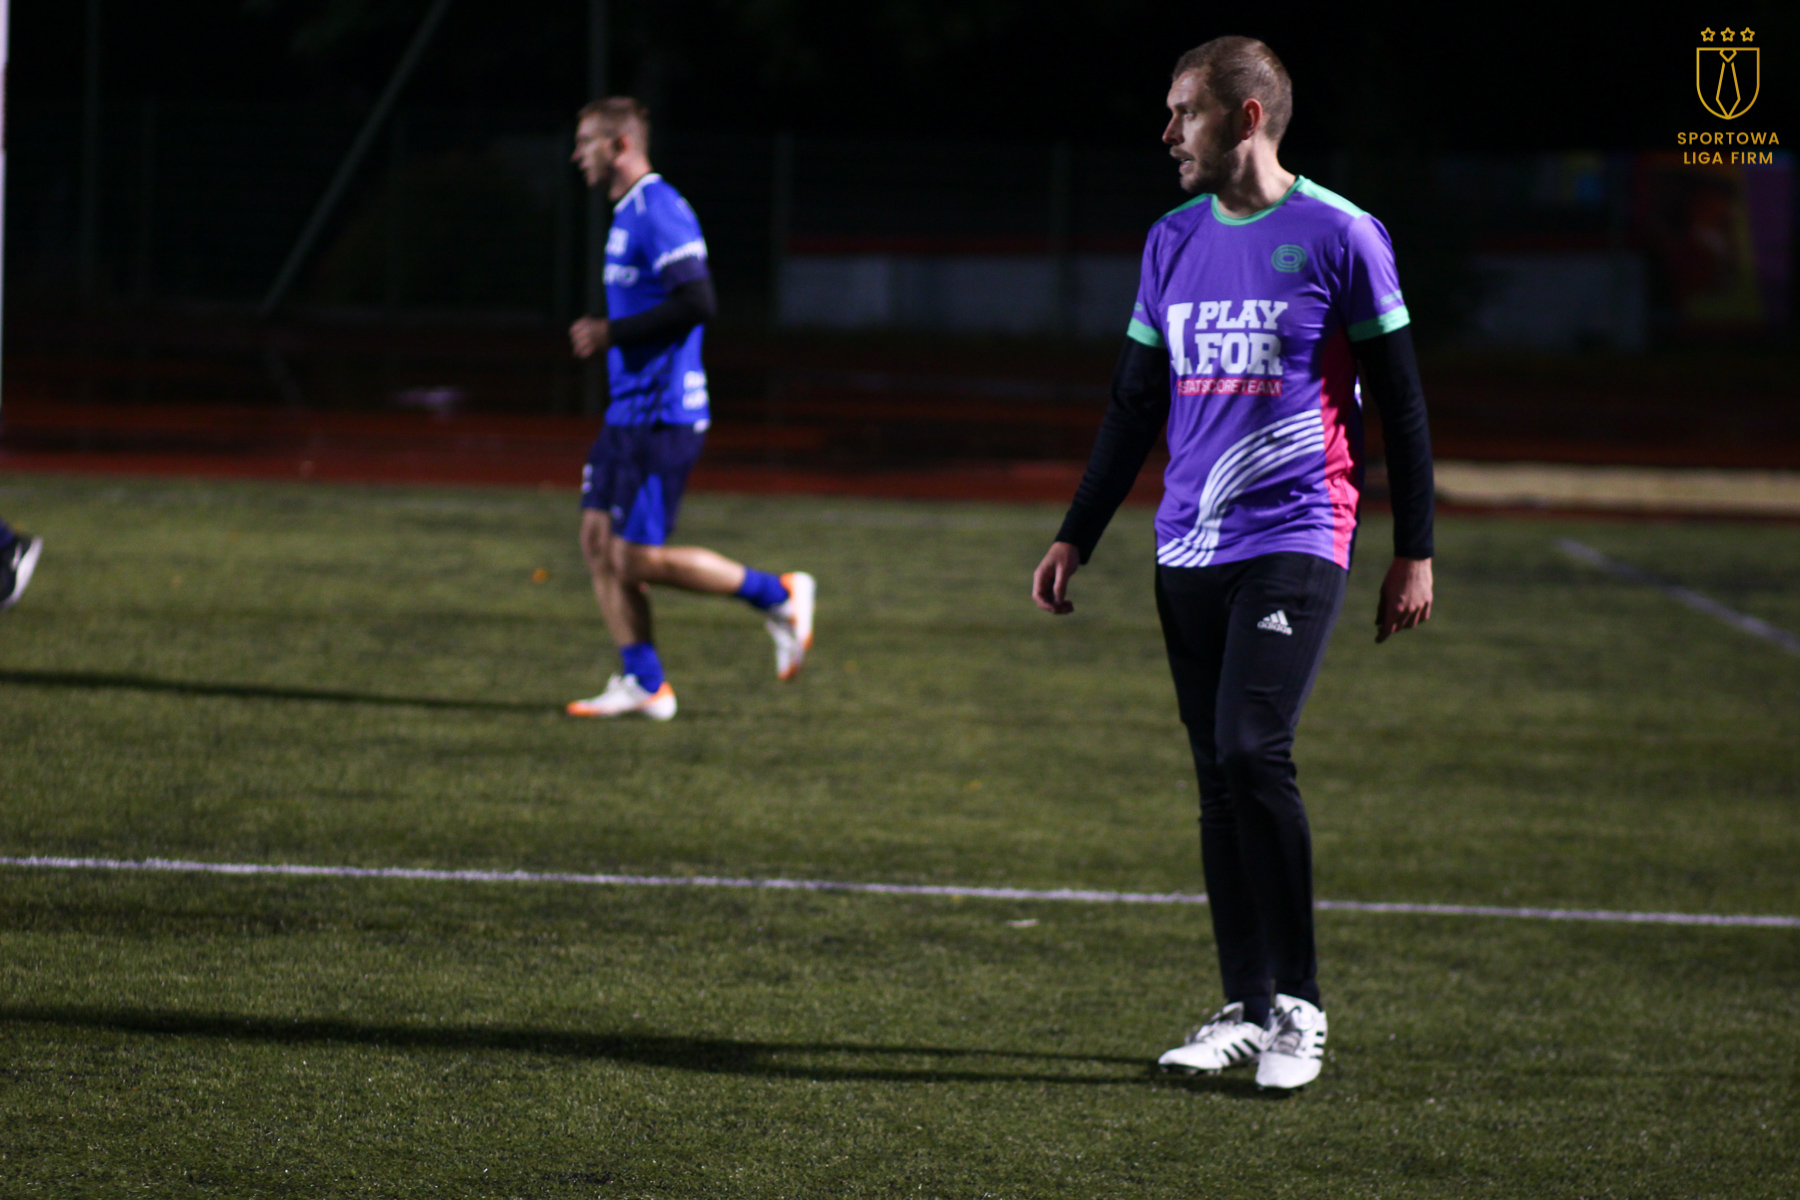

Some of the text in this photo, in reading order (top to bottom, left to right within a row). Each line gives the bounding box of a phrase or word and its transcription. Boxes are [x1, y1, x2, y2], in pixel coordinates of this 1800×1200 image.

[1167, 300, 1288, 376] I PLAY
[1195, 333, 1283, 376] FOR
[1256, 620, 1293, 636] adidas
